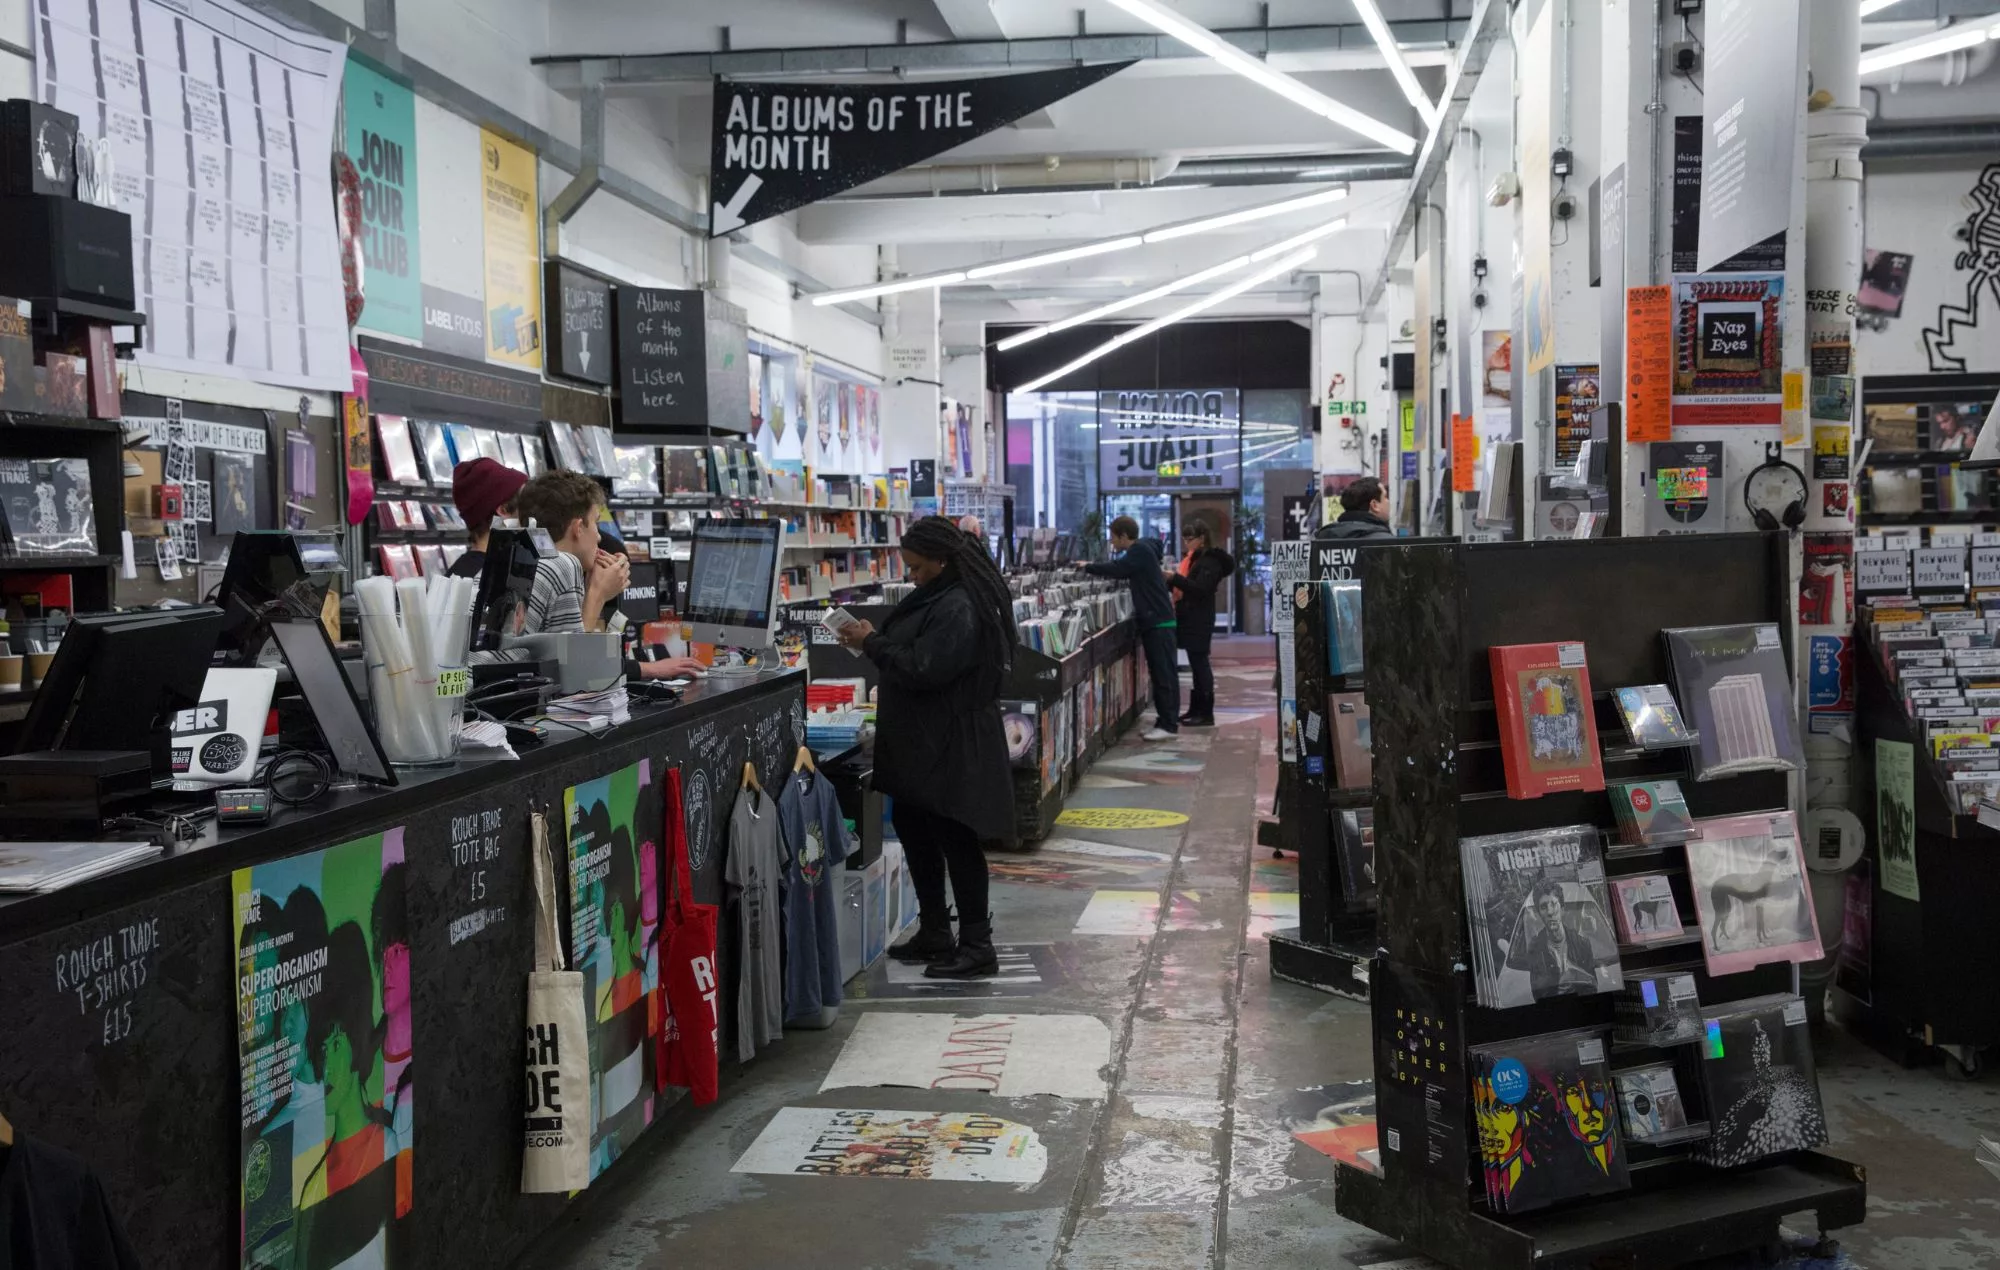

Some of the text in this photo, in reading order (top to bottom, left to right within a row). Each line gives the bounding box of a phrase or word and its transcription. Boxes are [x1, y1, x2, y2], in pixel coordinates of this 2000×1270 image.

[726, 92, 973, 132] ALBUMS OF THE
[358, 129, 404, 187] JOIN
[725, 135, 830, 170] MONTH
[362, 223, 409, 277] CLUB
[637, 292, 681, 312] Albums
[425, 307, 482, 338] LABEL FOCUS
[637, 318, 682, 337] of the
[1712, 321, 1746, 336] Nap
[642, 341, 677, 357] month
[1710, 338, 1747, 354] Eyes
[632, 368, 684, 385] Listen
[226, 428, 241, 447] THE
[244, 431, 264, 451] WEEK
[1272, 543, 1310, 565] JAMIE
[1320, 548, 1358, 565] NEW
[1321, 566, 1353, 580] AND
[1861, 575, 1881, 584] POST
[1918, 572, 1938, 581] POST
[623, 586, 656, 600] THINKING
[437, 685, 447, 695] 10
[440, 673, 451, 684] LP
[170, 707, 219, 731] ER
[452, 808, 502, 843] ROUGH TRADE
[453, 835, 500, 867] TOTE BAG
[570, 842, 612, 874] SUPERORGANISM
[1497, 842, 1580, 871] NIGHT SHOP
[471, 870, 486, 901] £5
[570, 860, 611, 891] SUPERORGANISM
[56, 917, 160, 993] ROUGH TRADE
[240, 931, 294, 959] ALBUM OF THE MONTH
[240, 946, 328, 999] SUPERORGANISM
[75, 956, 147, 1015] T-SHIRTS
[240, 972, 322, 1025] SUPERORGANISM
[103, 1001, 132, 1046] £15
[275, 1036, 290, 1050] MEETS
[288, 1042, 301, 1056] WITH
[273, 1063, 284, 1076] AND
[795, 1111, 875, 1173] BATTLES
